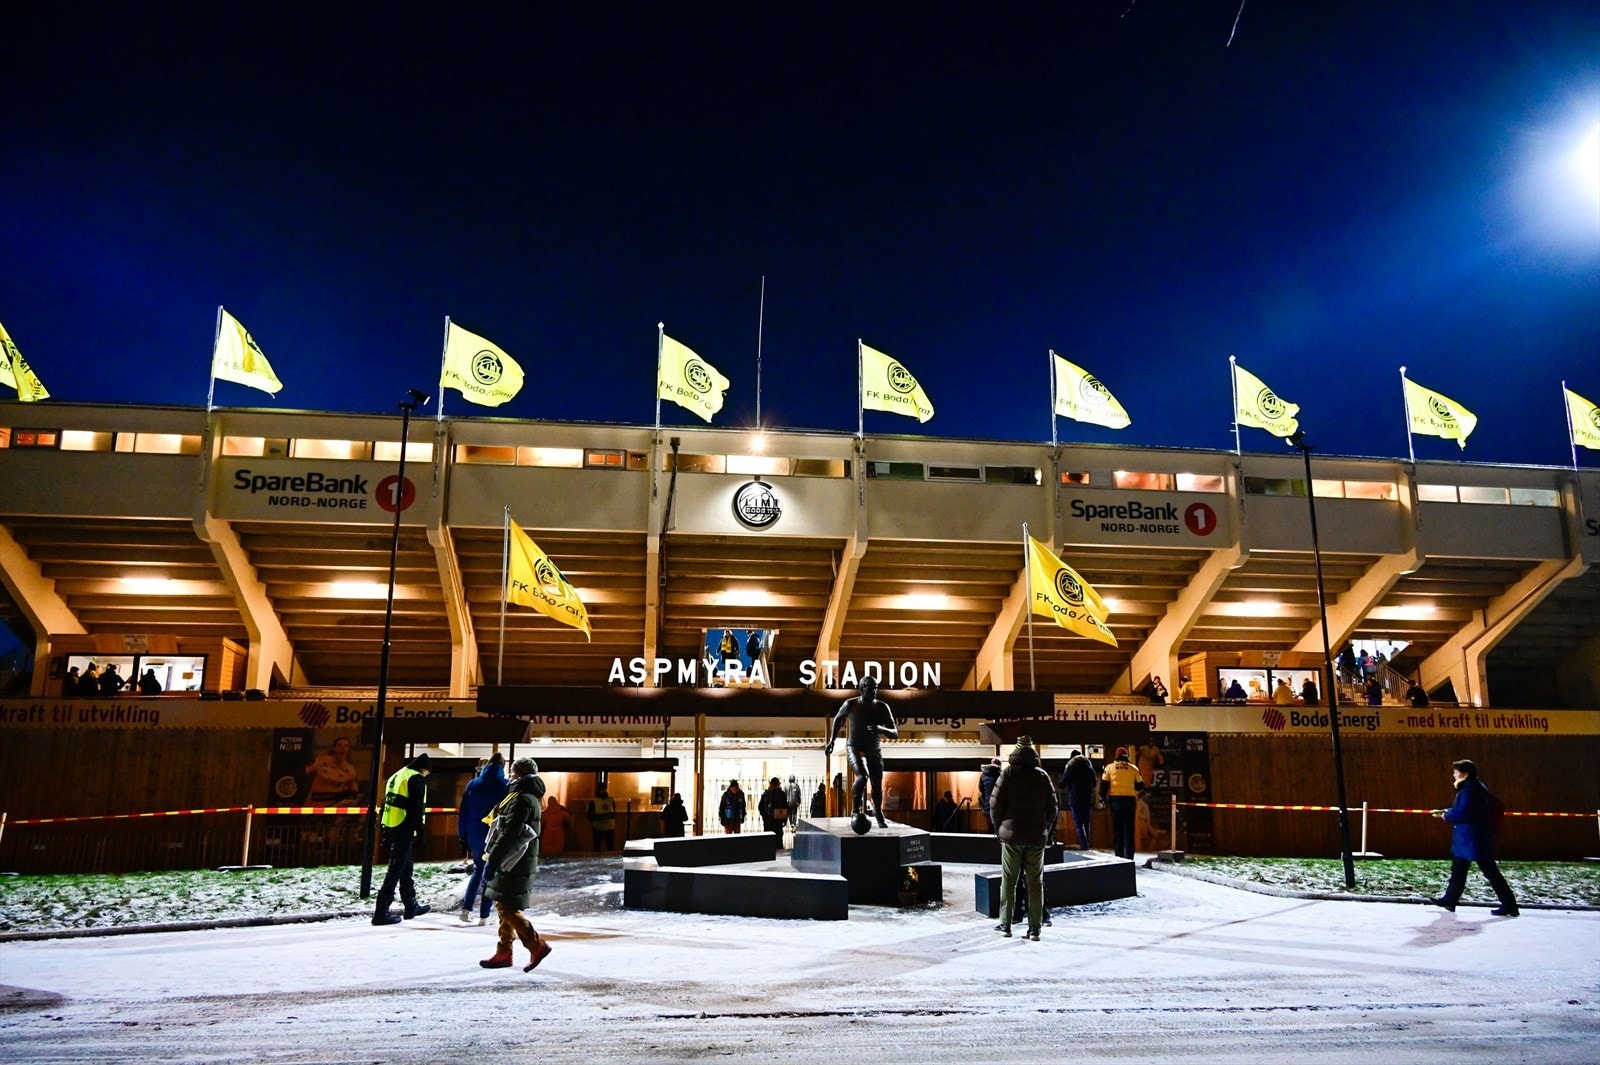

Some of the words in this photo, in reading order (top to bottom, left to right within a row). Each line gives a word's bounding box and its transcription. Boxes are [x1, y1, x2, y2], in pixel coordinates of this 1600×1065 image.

[445, 370, 460, 380] FK
[660, 380, 674, 392] FK
[866, 390, 880, 399] FK
[233, 469, 369, 494] SpareBank
[268, 495, 368, 509] NORD-NORGE
[1070, 500, 1179, 522] SpareBank
[1193, 508, 1207, 530] 1
[1100, 523, 1181, 534] NORD-NORGE
[512, 580, 529, 593] FK
[1036, 592, 1053, 605] FK
[607, 657, 768, 685] ASPMYRA
[798, 660, 942, 686] STADION
[0, 704, 46, 723] kraft
[52, 705, 74, 723] til
[78, 705, 161, 727] utvikling
[336, 705, 378, 723] Bod
[1290, 711, 1330, 728] Bodø
[1337, 711, 1381, 731] Energi
[1407, 713, 1435, 728] med
[1439, 713, 1471, 728] kraft
[1475, 713, 1489, 728] til
[1493, 713, 1549, 732] utvikling
